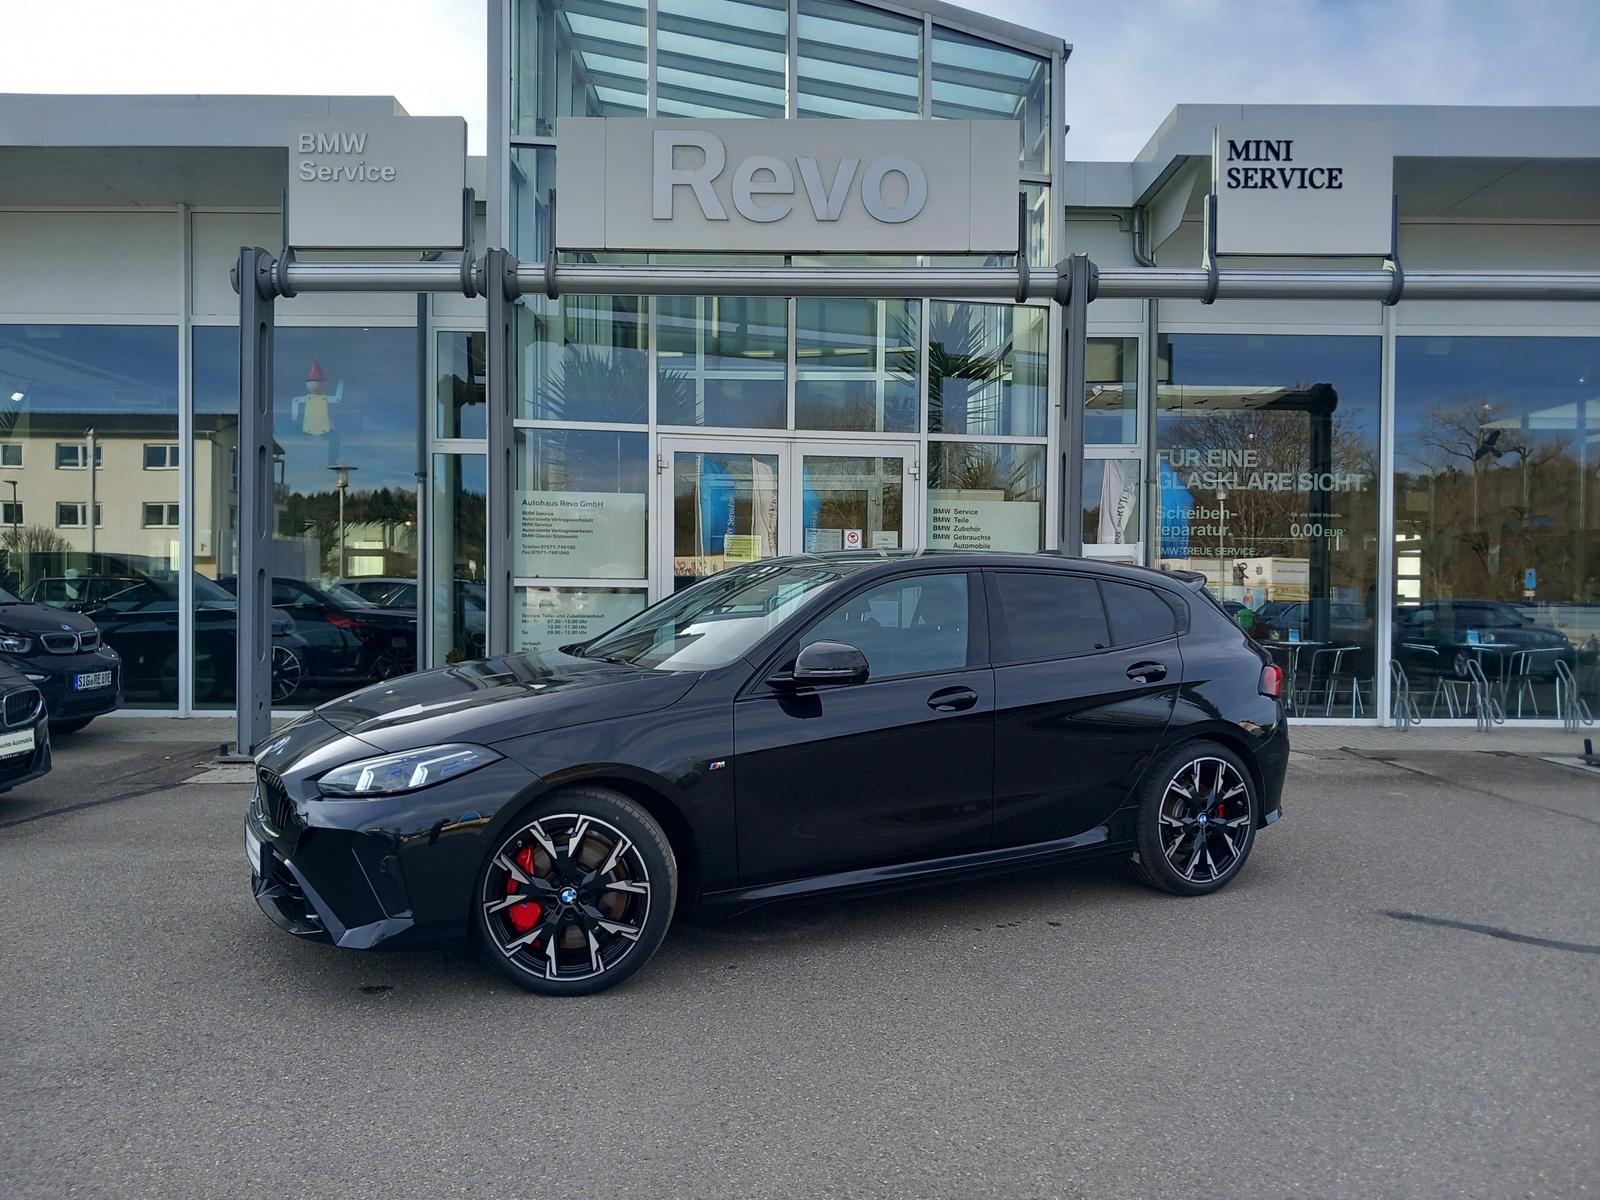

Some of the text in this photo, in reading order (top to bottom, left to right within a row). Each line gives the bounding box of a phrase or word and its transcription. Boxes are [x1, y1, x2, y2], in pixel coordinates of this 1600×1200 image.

[298, 132, 368, 154] BMW
[1227, 140, 1293, 162] MINI
[299, 160, 397, 182] Service
[652, 129, 929, 224] Revo
[1227, 167, 1343, 189] SERVICE
[1156, 445, 1257, 468] FÜR EINE
[1156, 471, 1368, 492] GLASKLARE SICHT.
[521, 499, 559, 507] Autohaus
[953, 508, 978, 516] Service
[1156, 505, 1238, 520] Scheiben-
[953, 525, 981, 533] Zubehör
[1290, 523, 1323, 539] 0,00
[932, 533, 992, 542] BMW Gebrauchte
[953, 543, 991, 551] Automobile
[1215, 547, 1259, 556] SERVICE.
